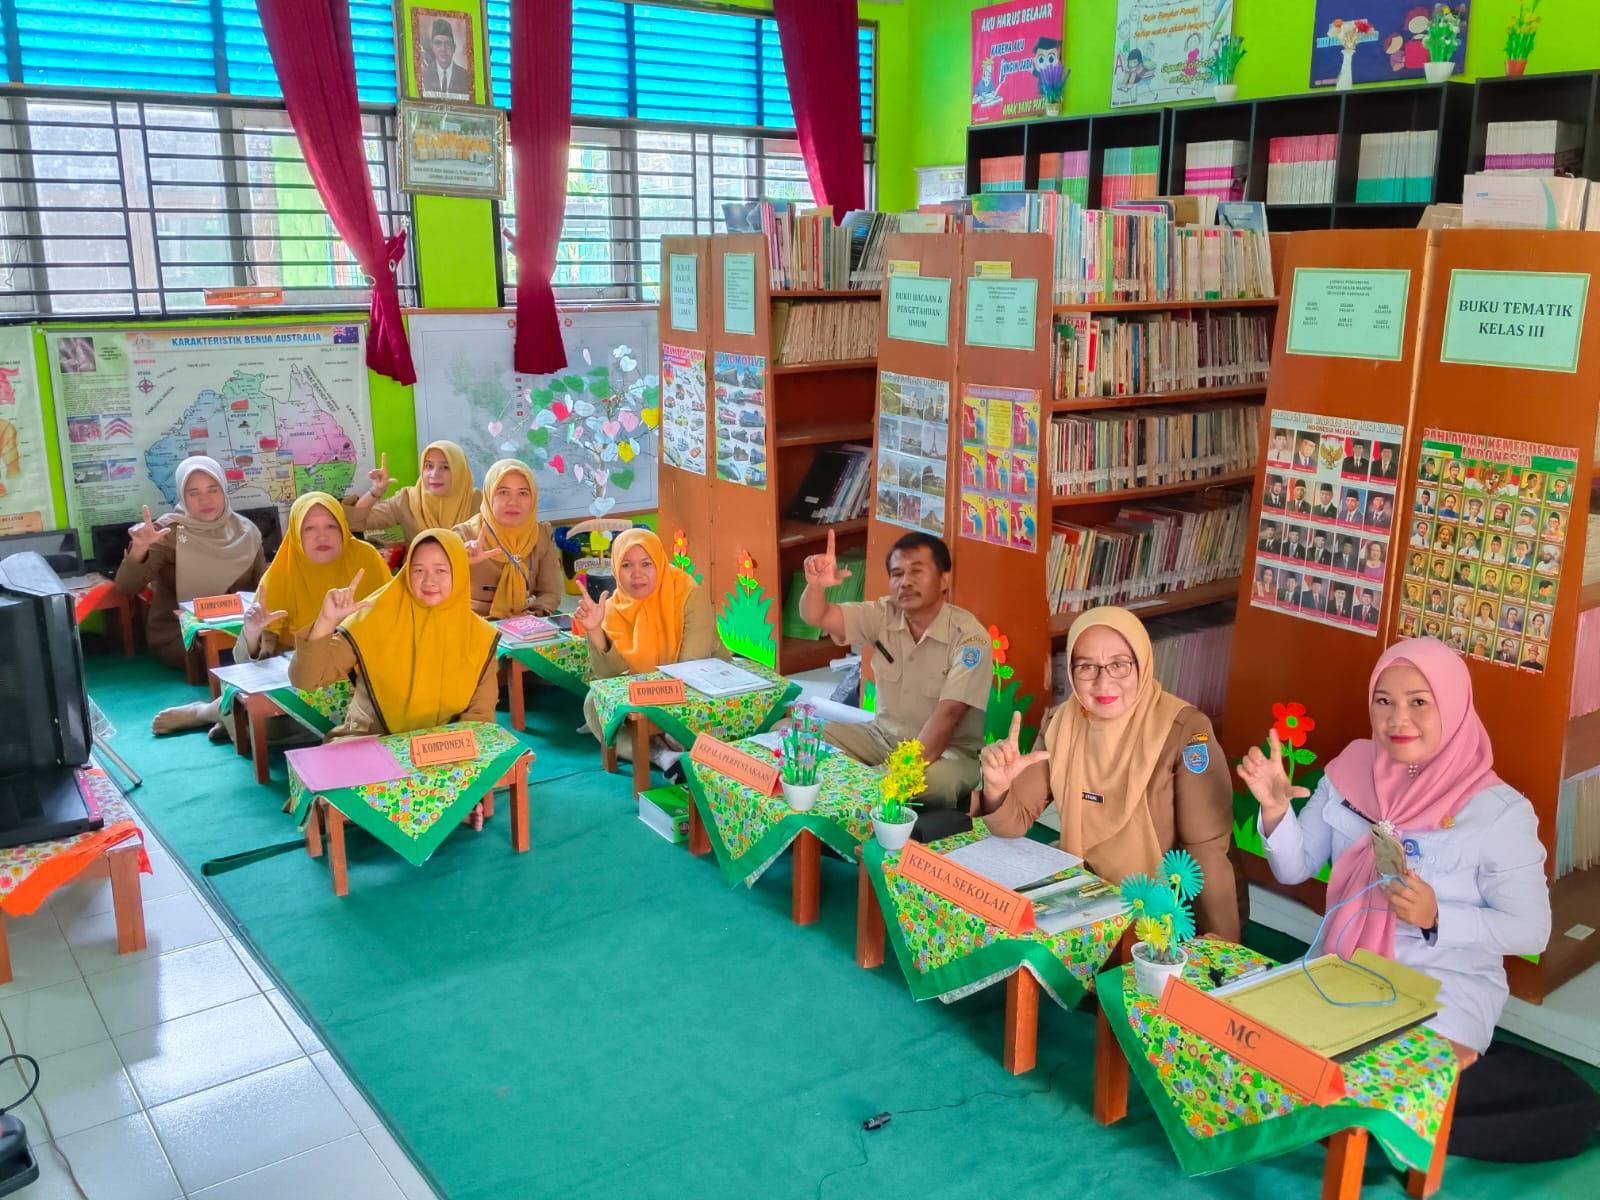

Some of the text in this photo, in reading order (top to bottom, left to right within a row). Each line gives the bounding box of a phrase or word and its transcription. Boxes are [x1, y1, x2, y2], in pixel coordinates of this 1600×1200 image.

[981, 3, 1053, 32] AKU HARUS BELAJAR
[895, 292, 911, 301] BUKU
[896, 304, 940, 317] PENGETAHUAN
[1459, 300, 1573, 317] BUKU TEMATIK
[908, 319, 927, 328] UMUM
[1479, 322, 1545, 338] KELAS III
[171, 333, 321, 346] KARAKTERISTIK BENUA AUSTRALIA
[1424, 429, 1579, 459] PAHLAWAN KEMERDEKAAN
[1462, 446, 1531, 467] INDONESIA
[637, 685, 679, 696] KOMPONEN 1
[422, 738, 471, 753] KOMPONEN 2
[700, 743, 770, 781] KEPALA PERPUSTAKAAN
[909, 854, 1010, 913] KEPALA SEKOLAH
[1225, 1018, 1261, 1048] MC
